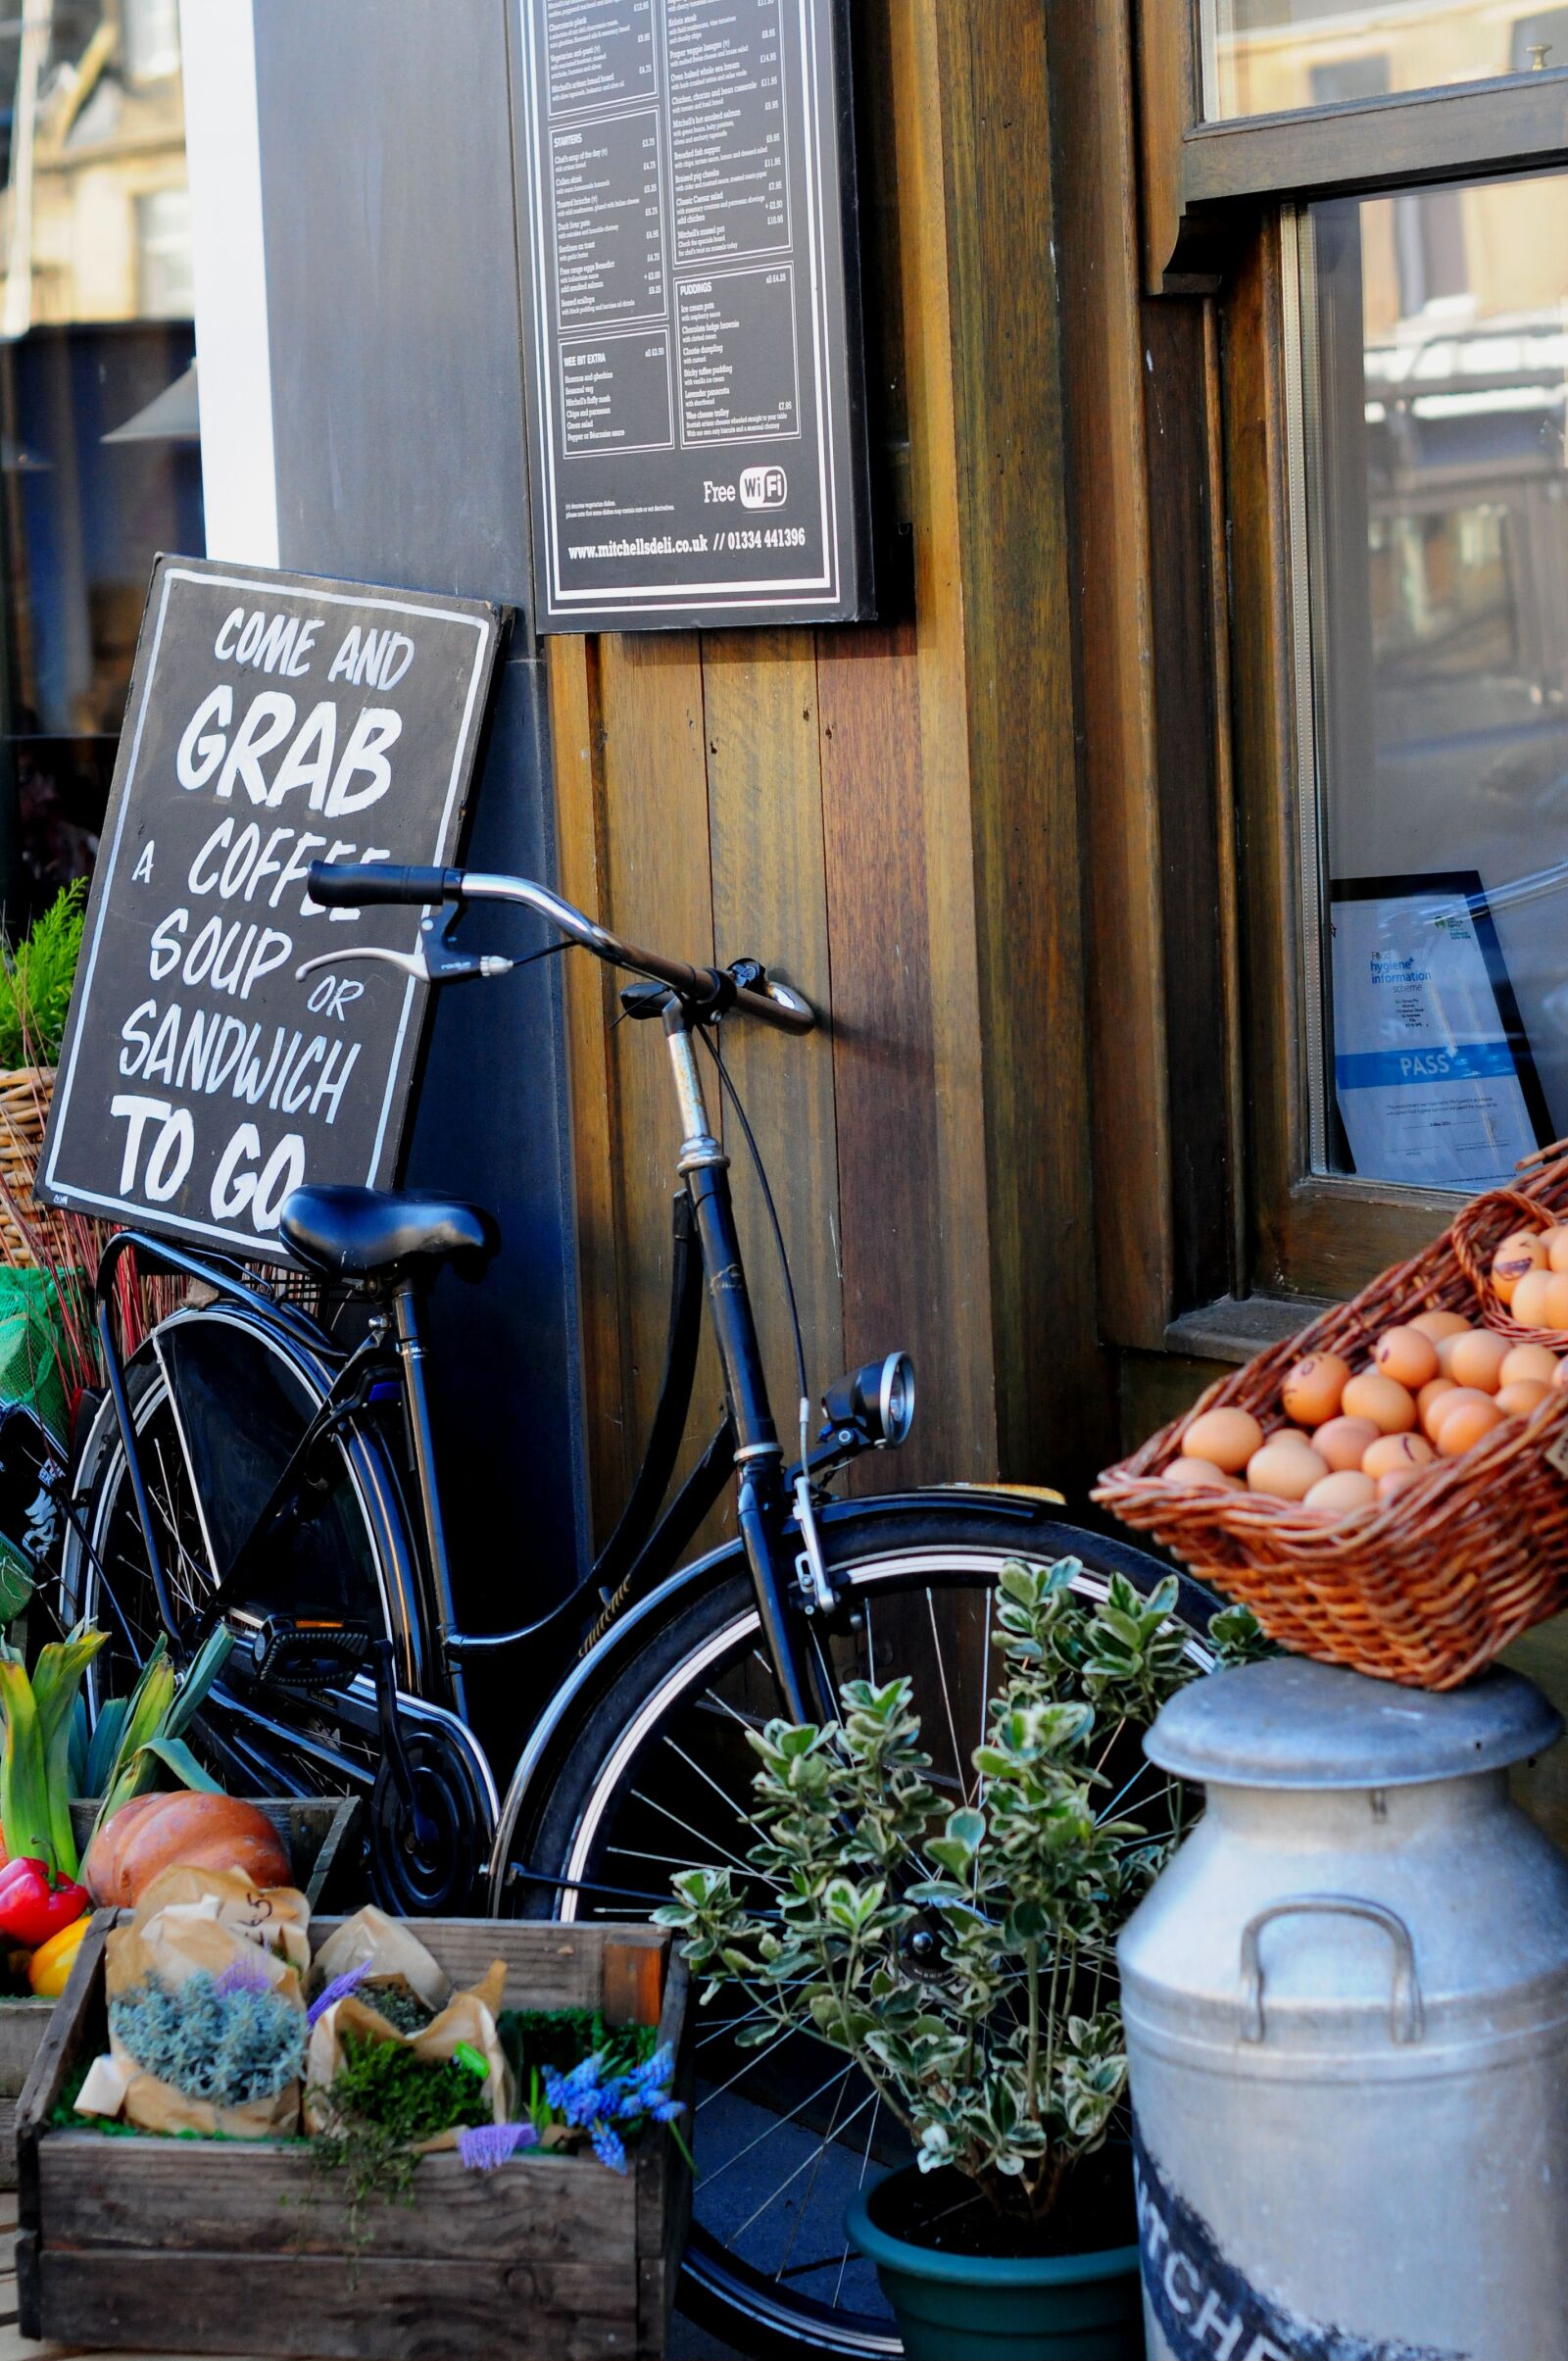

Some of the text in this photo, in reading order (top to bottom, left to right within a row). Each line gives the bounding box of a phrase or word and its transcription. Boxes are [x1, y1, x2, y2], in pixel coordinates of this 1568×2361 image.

[680, 281, 712, 296] PUDDINGS
[576, 355, 587, 366] BIT
[587, 353, 607, 365] EXTRA
[703, 480, 736, 504] Free
[567, 534, 708, 560] www.mitchellsdeli.co.uk
[727, 530, 761, 550] 01334
[763, 527, 806, 548] 441396
[214, 607, 415, 691] COME AND
[176, 684, 403, 817] GRAB
[131, 839, 155, 883] A
[150, 908, 365, 1021] SOUP OR
[1371, 971, 1432, 984] information
[1393, 983, 1423, 994] scheme
[119, 999, 362, 1124] SANDWICH
[1399, 1054, 1449, 1076] PASS
[110, 1095, 306, 1233] TO GO
